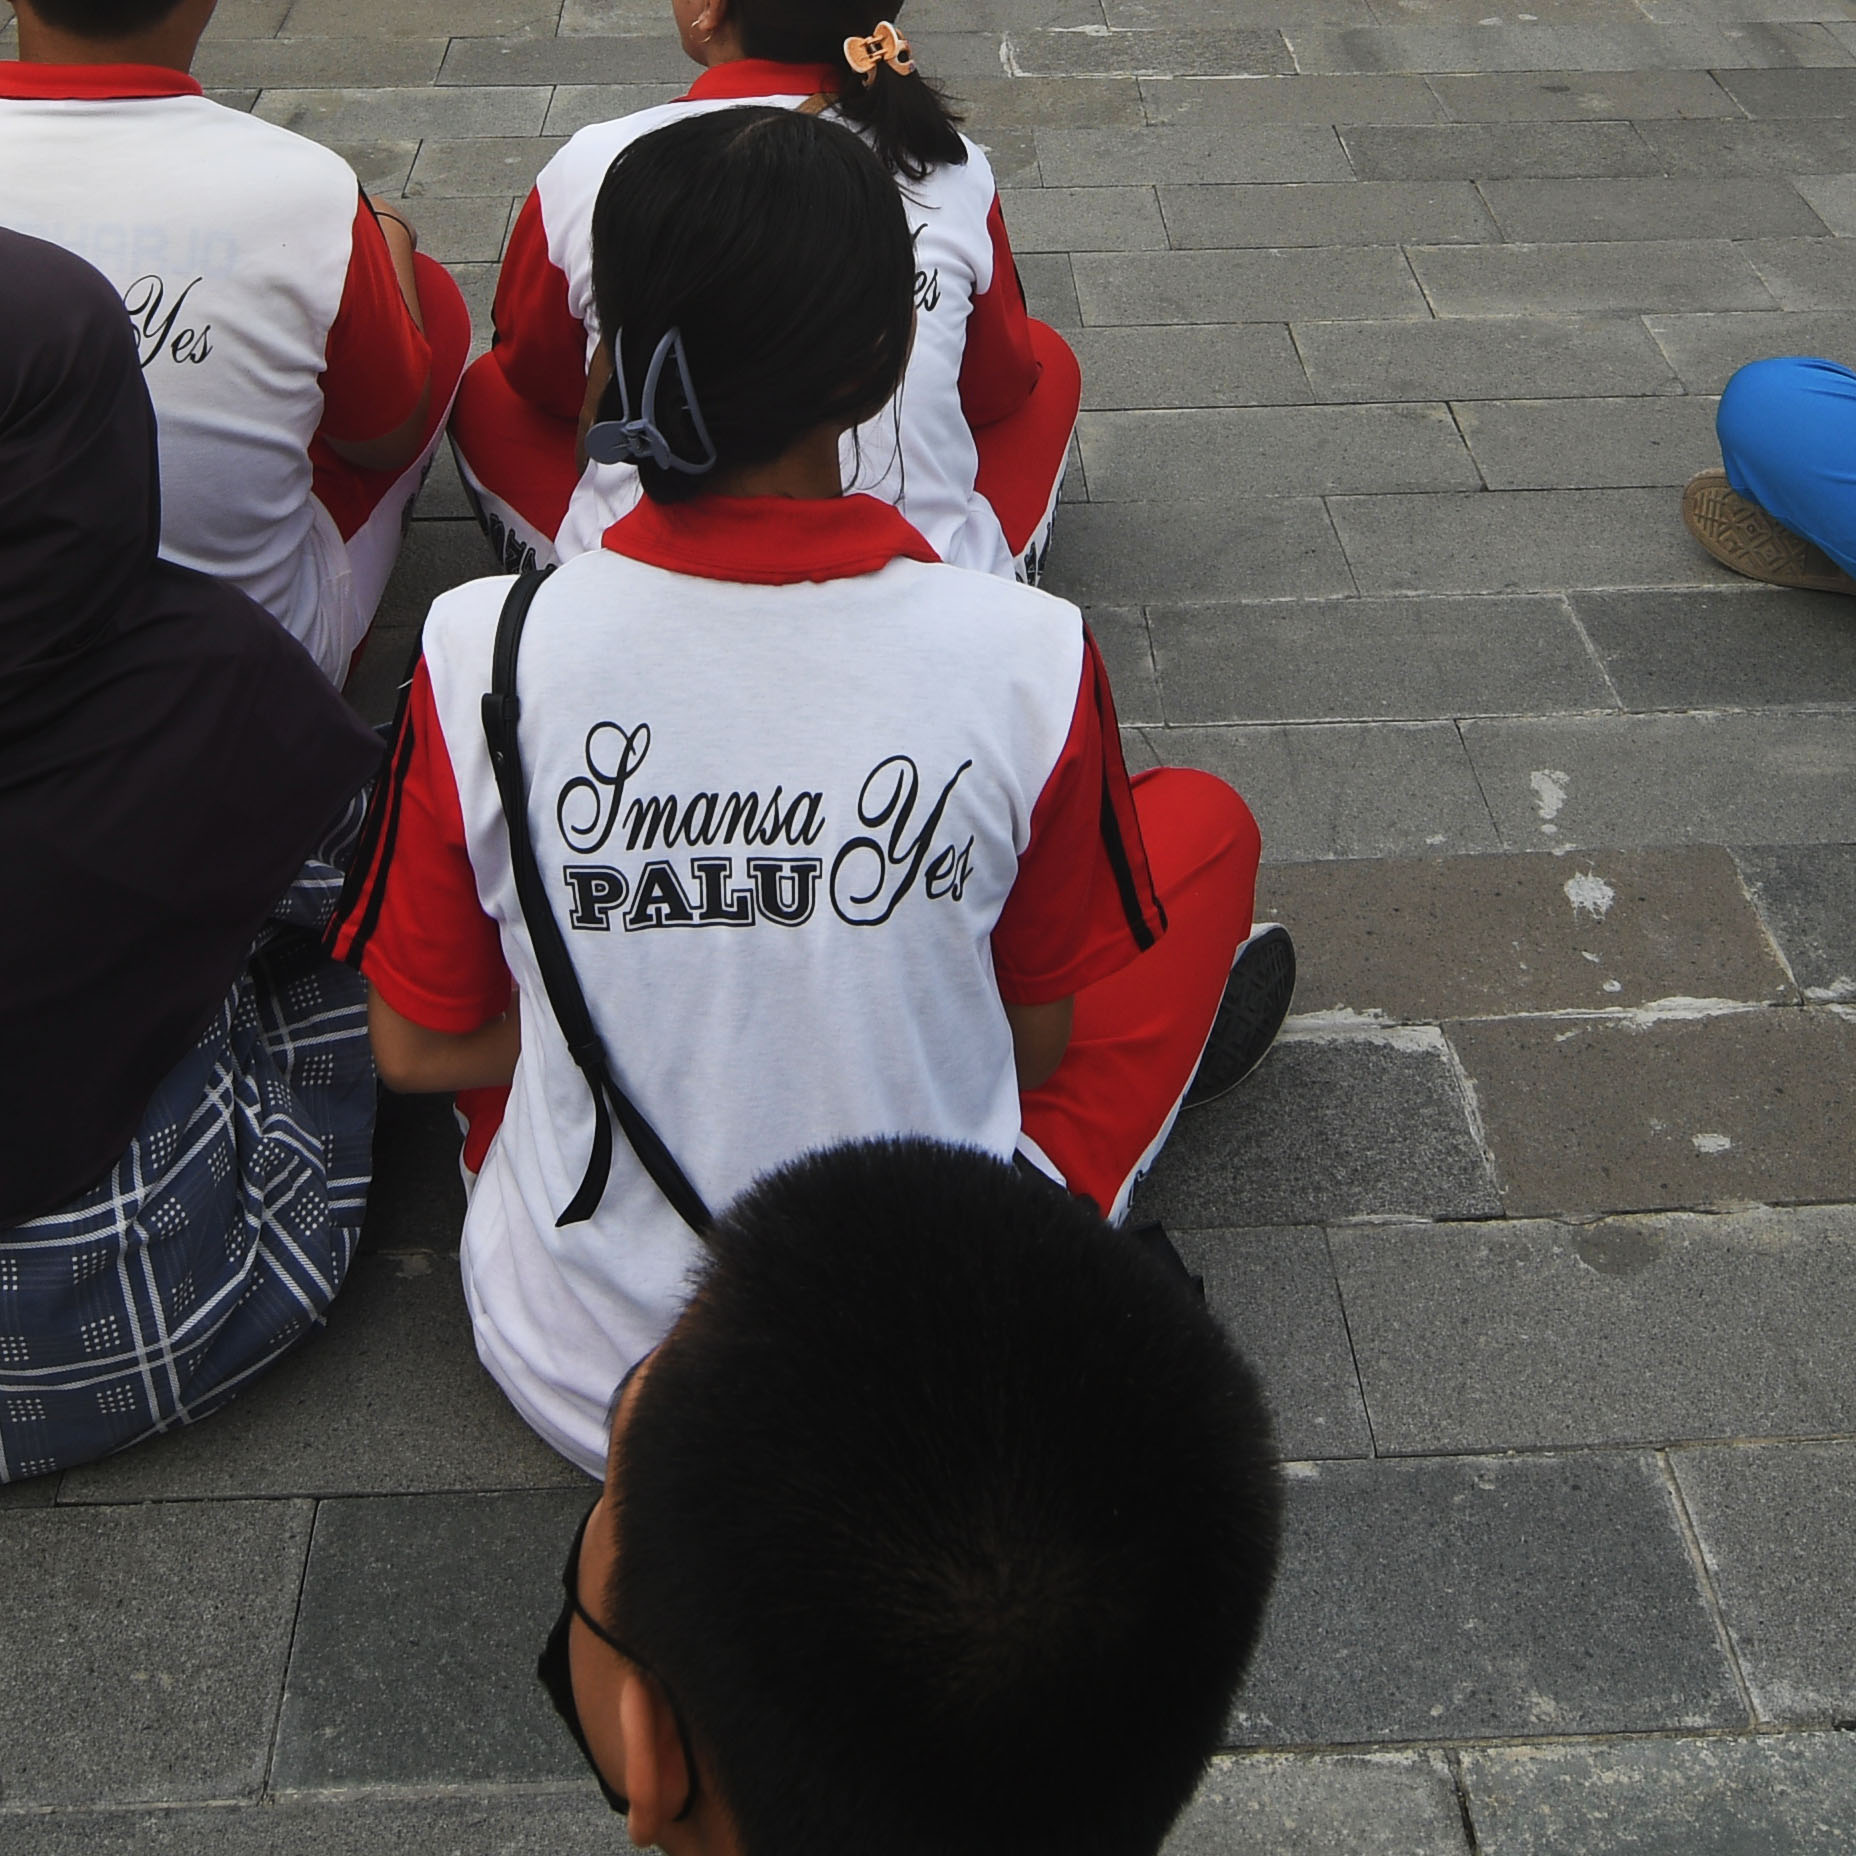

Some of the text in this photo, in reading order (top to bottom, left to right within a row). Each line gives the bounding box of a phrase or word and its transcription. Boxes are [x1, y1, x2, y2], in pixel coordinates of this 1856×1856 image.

[124, 275, 213, 369] Yes
[557, 721, 974, 926] Smansa Yes
[563, 857, 823, 932] PALU
